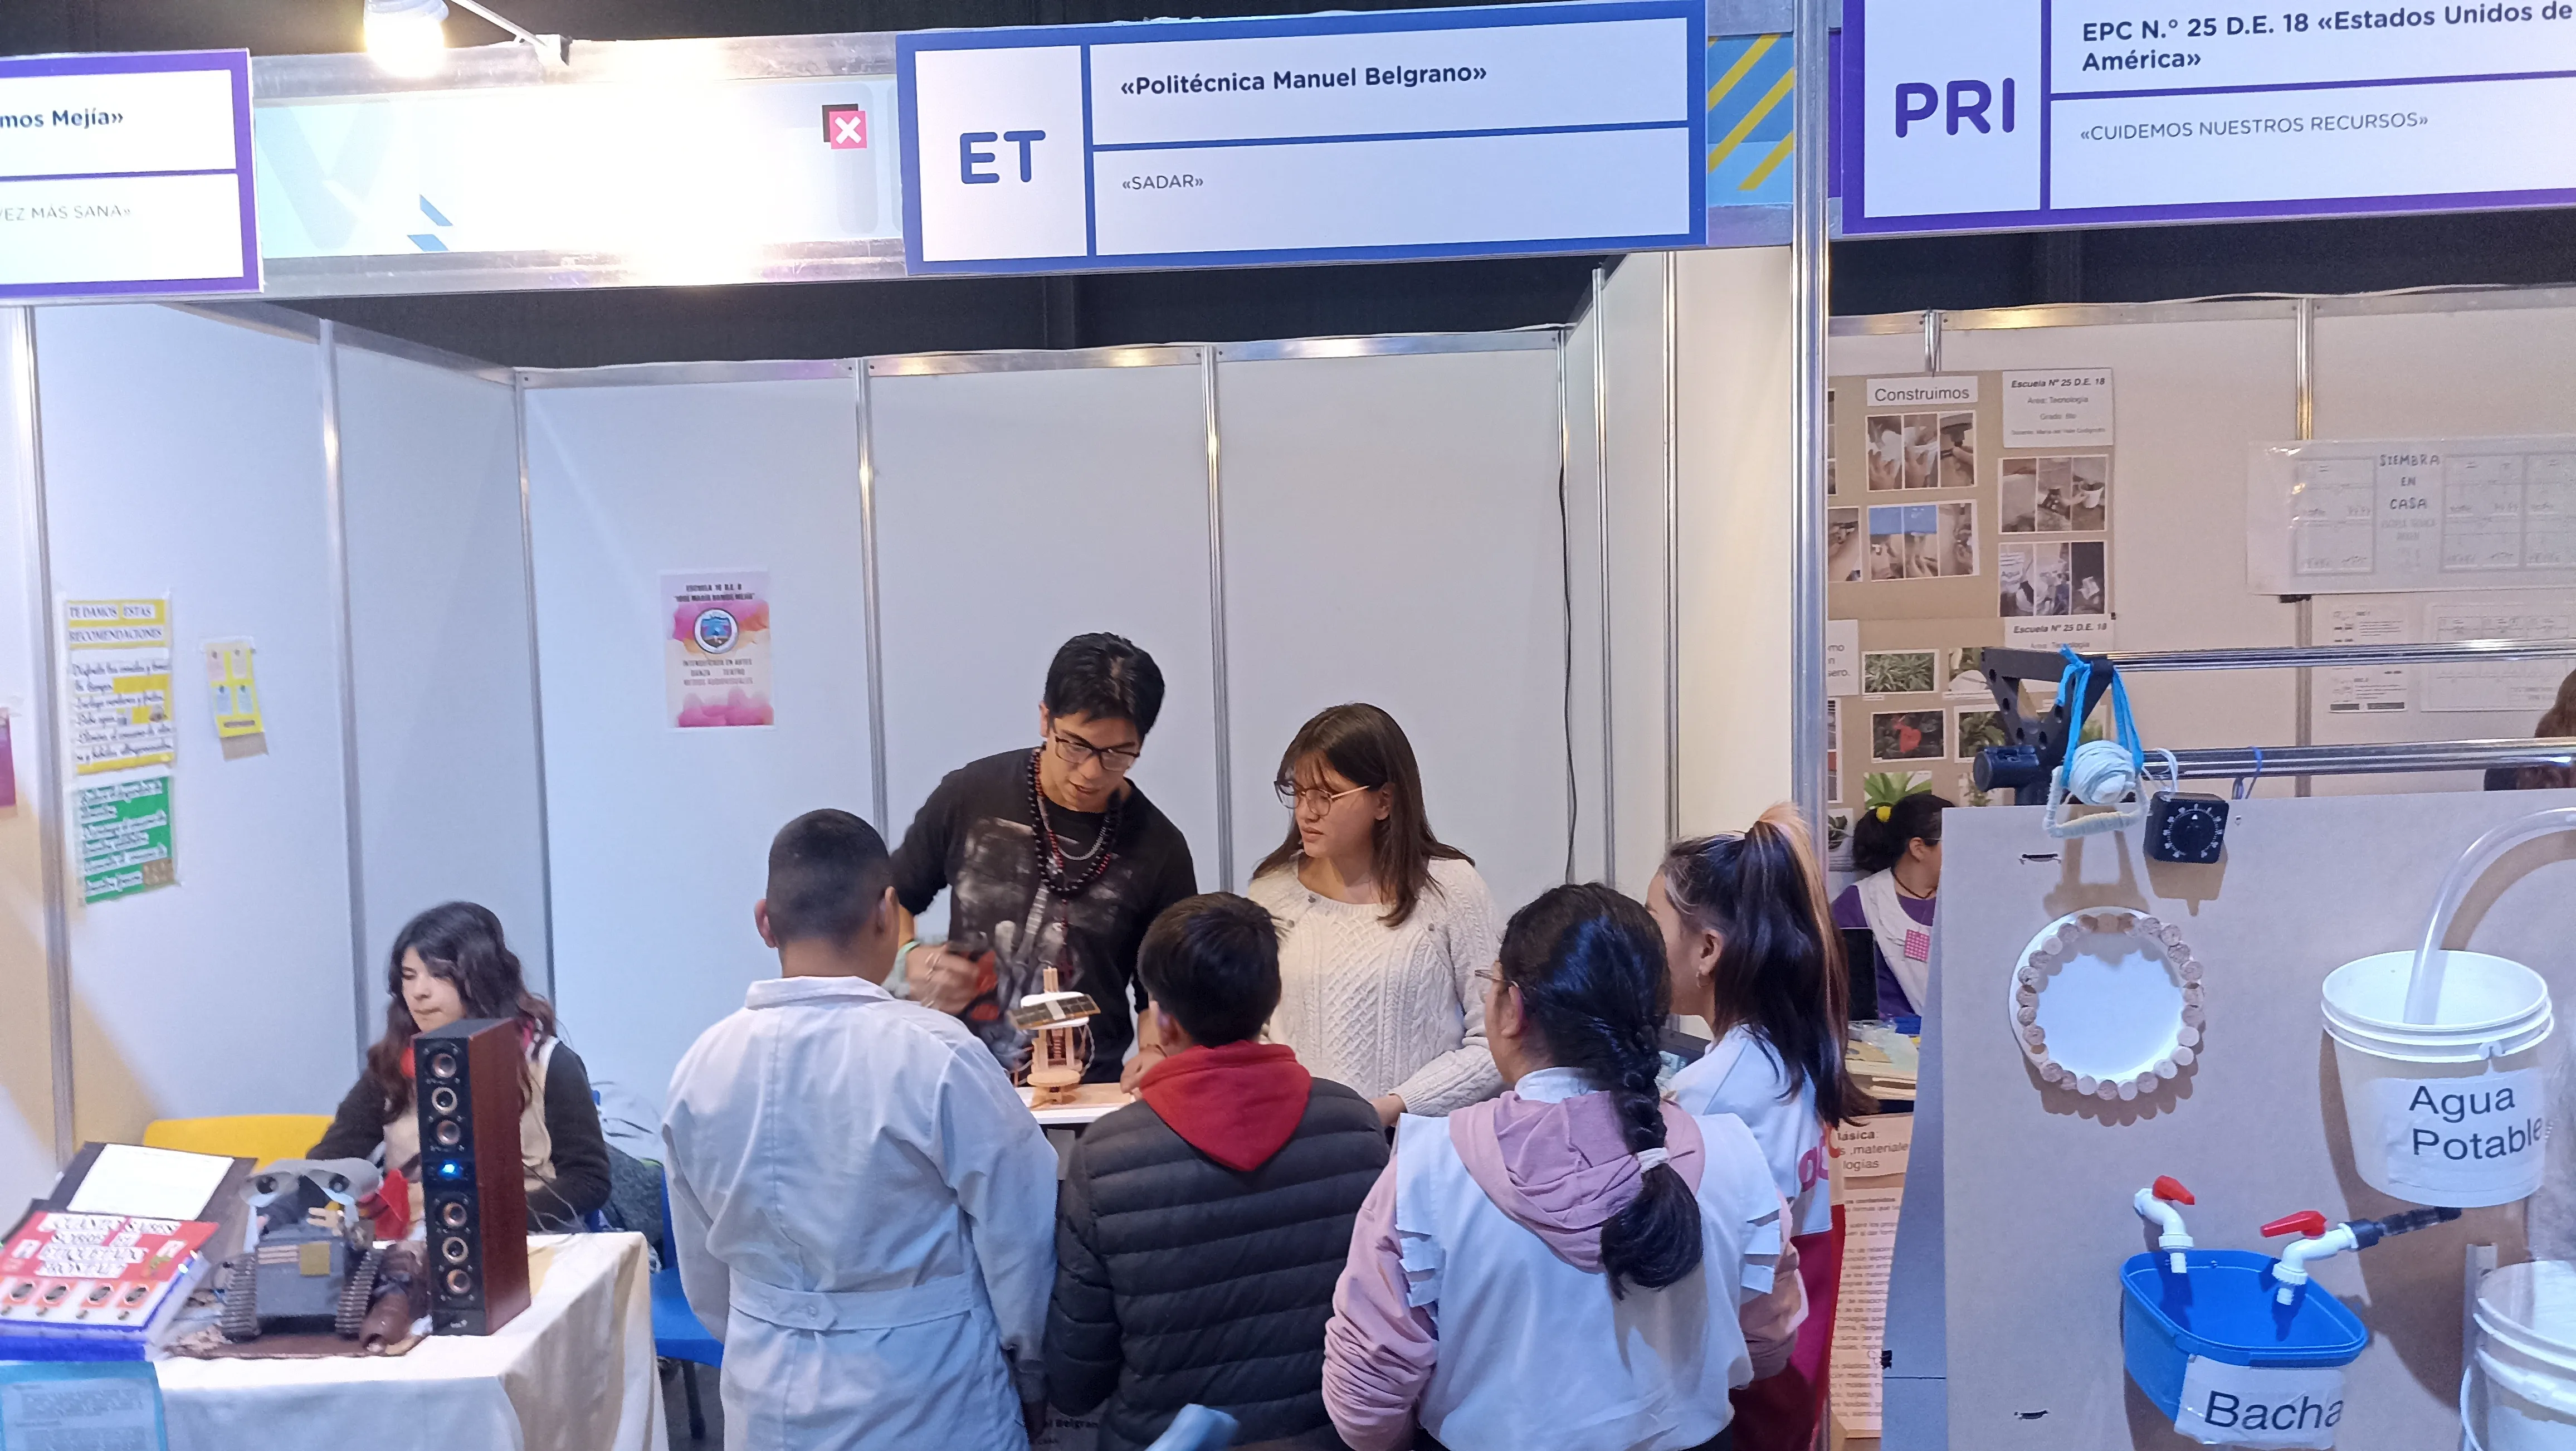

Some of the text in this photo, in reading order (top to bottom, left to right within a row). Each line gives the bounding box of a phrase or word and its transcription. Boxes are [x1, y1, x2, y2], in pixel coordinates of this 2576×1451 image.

[2083, 21, 2133, 42] EPC
[2187, 17, 2217, 37] 25
[2227, 15, 2274, 35] D.E.
[2283, 13, 2309, 33] 18
[2318, 7, 2435, 31] «Estados
[2445, 3, 2533, 25] Unidos
[2542, 1, 2573, 20] de
[2082, 49, 2201, 72] América»
[1121, 66, 1487, 95] «Politécnica Manuel Belgrano»
[0, 107, 124, 129] mos Mejía»
[1895, 77, 2015, 138] PRI
[2081, 112, 2428, 142] «CUIDEMOS NUESTROS RECURSOS»
[959, 130, 1046, 184] ET
[1122, 174, 1204, 190] «SADAR»
[1875, 386, 1970, 401] Construimos
[2379, 454, 2440, 467] SIEMBRA
[2401, 476, 2417, 486] EN
[2389, 497, 2428, 510] CASA
[2408, 1085, 2516, 1123] Agua
[2412, 1117, 2544, 1161] Potable
[2204, 1390, 2344, 1430] Bacha
